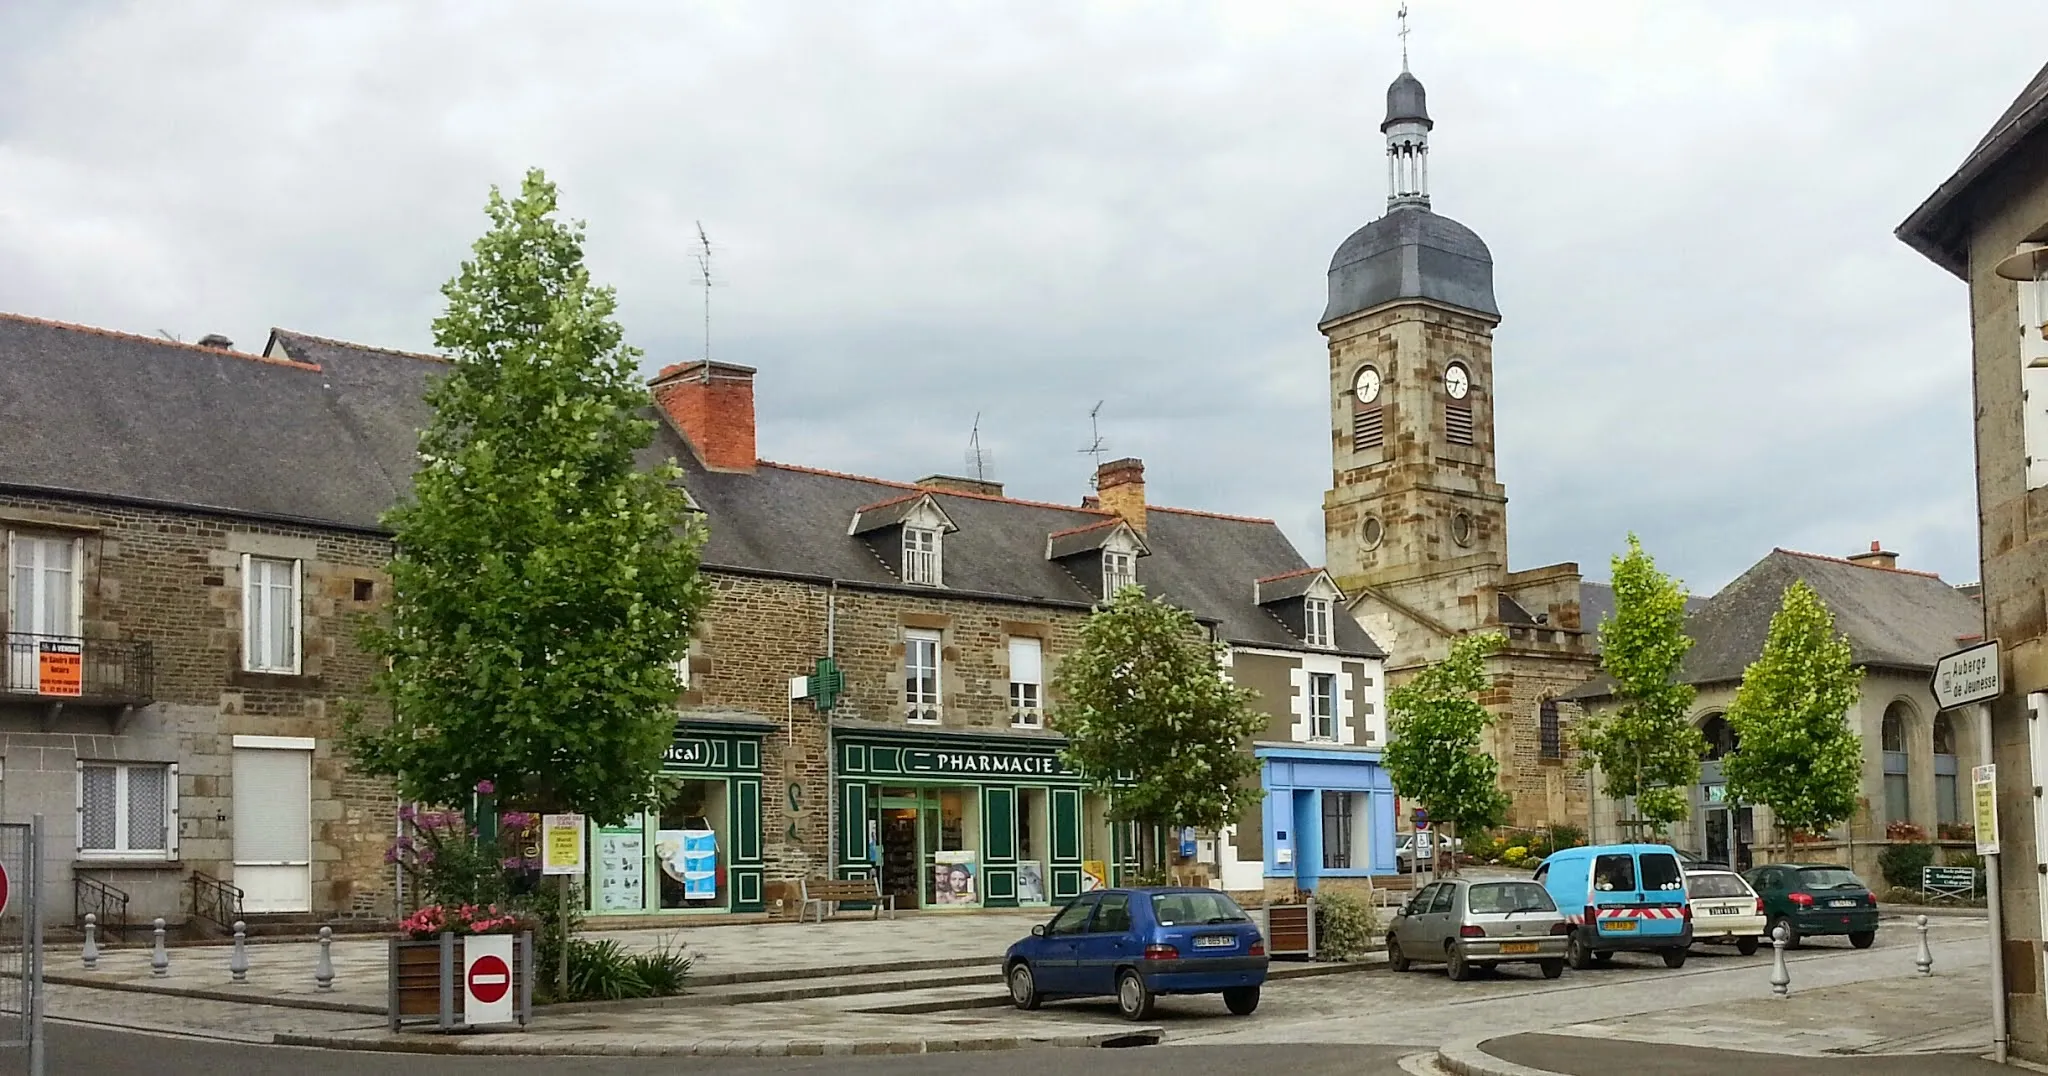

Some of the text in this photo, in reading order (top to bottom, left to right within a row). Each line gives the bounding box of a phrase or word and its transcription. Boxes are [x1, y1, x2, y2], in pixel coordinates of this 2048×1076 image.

[1953, 657, 1986, 677] Auberge
[1953, 676, 1996, 697] de Jeunesse
[937, 753, 1054, 774] PHARMACIE
